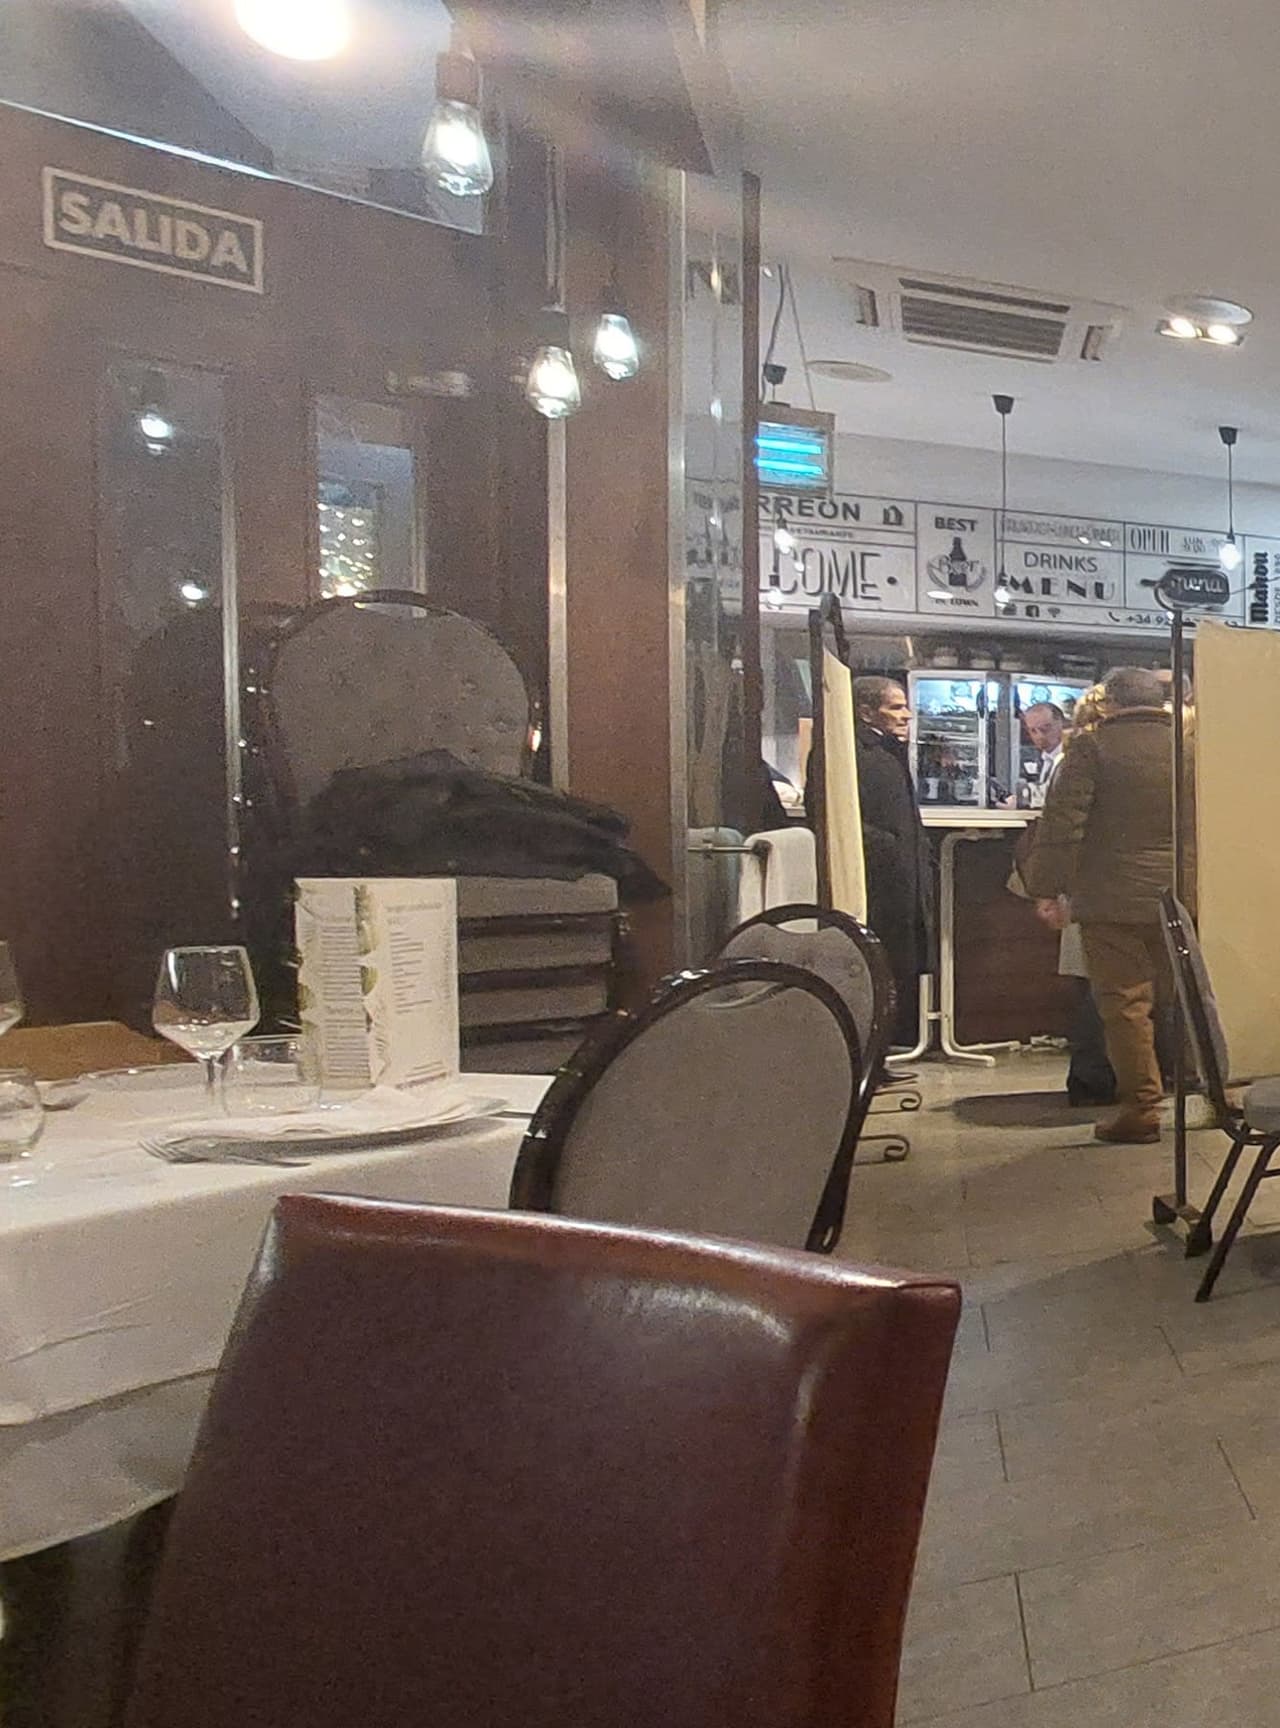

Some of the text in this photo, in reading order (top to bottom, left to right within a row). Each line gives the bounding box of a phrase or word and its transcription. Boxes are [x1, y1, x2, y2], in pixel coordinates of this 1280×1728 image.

[59, 191, 248, 272] SALIDA
[934, 516, 978, 532] BEST
[1024, 551, 1098, 573] DRINKS
[1008, 575, 1115, 600] MENU
[1250, 552, 1269, 623] Mahou
